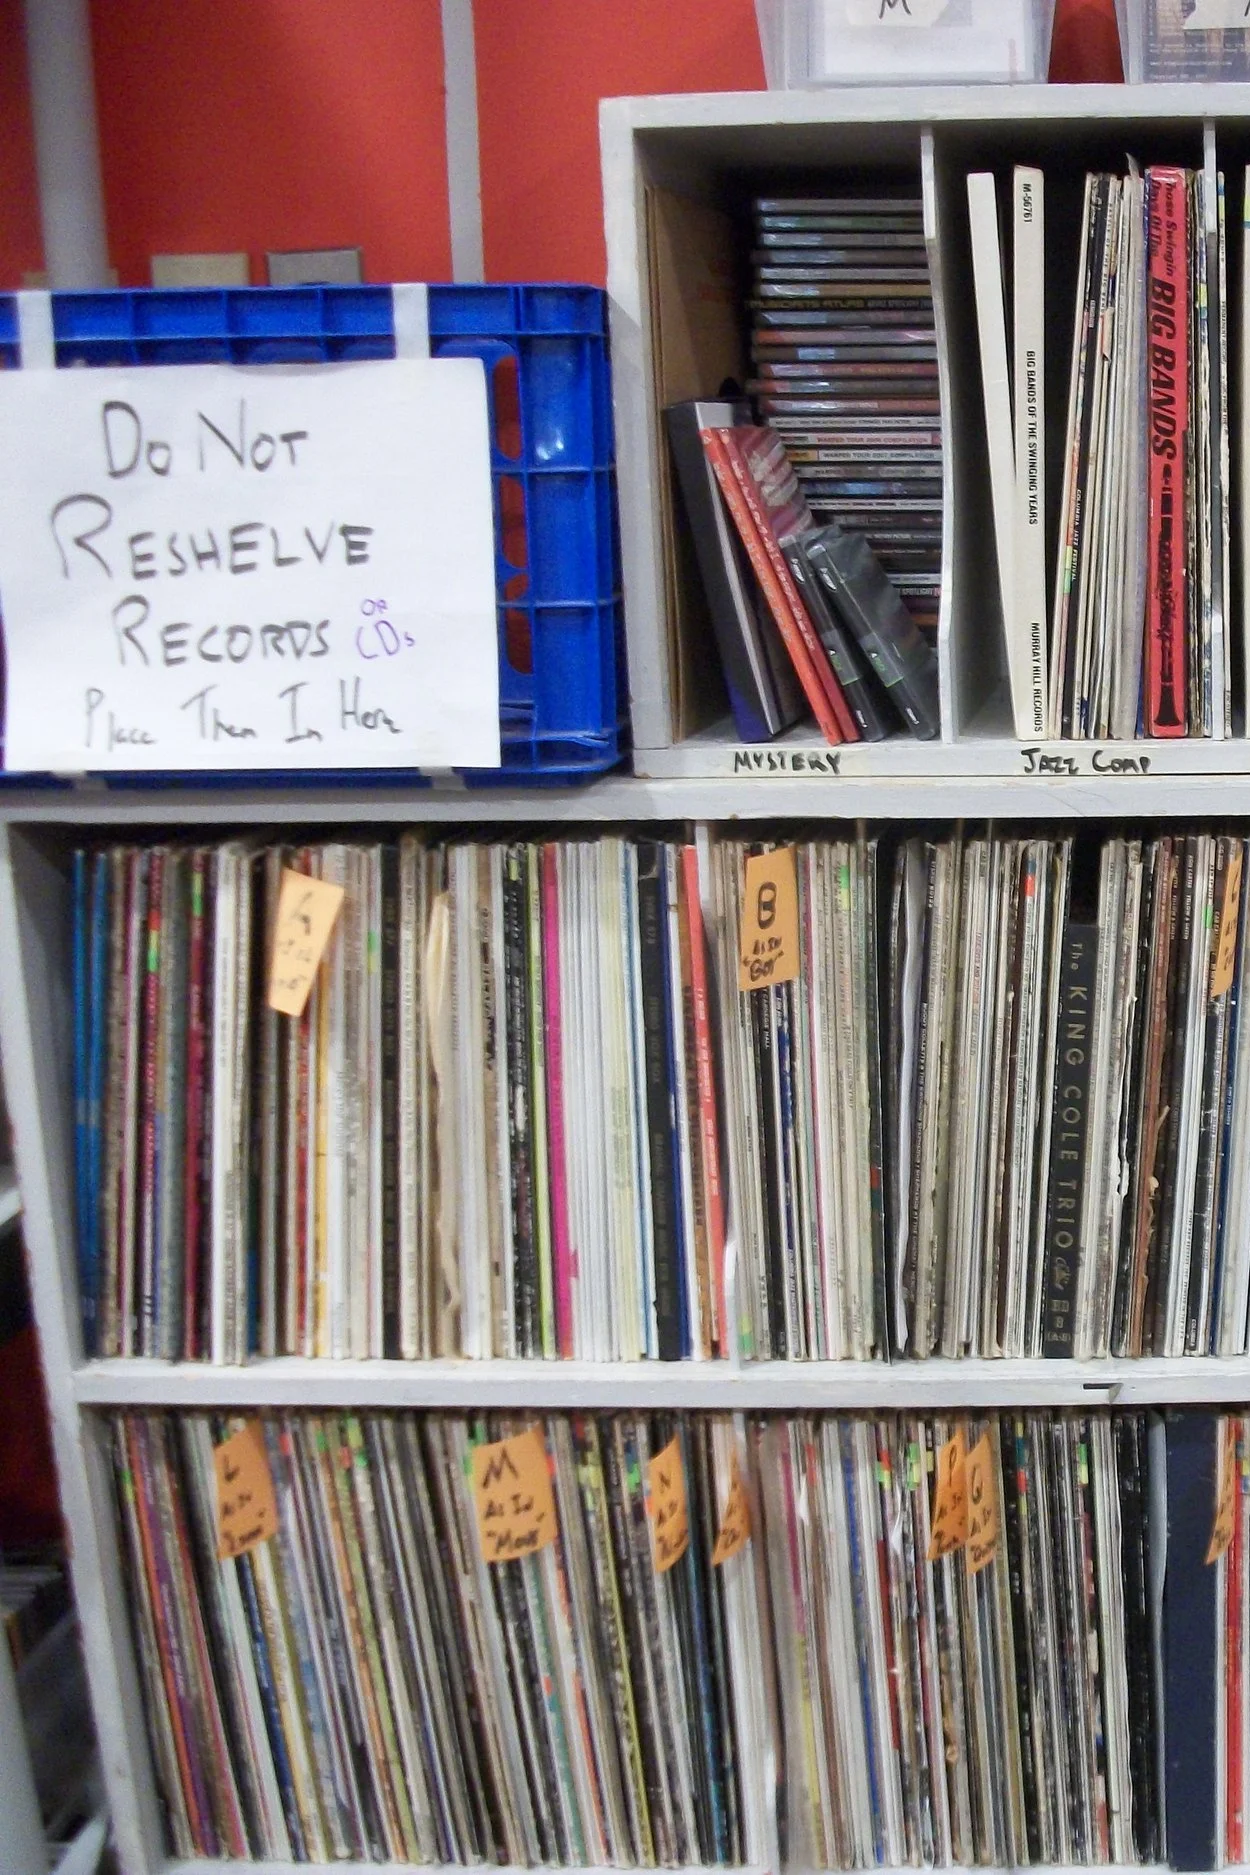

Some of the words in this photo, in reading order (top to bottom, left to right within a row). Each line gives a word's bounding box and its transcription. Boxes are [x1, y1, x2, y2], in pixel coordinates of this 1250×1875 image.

[1023, 184, 1032, 223] M-56761
[1164, 220, 1177, 277] Swingin
[1151, 278, 1176, 339] BIG
[1026, 351, 1036, 368] BIG
[1026, 370, 1036, 403] BANDS
[1152, 344, 1176, 460] BANDS
[1027, 406, 1037, 418] OF
[1028, 421, 1037, 440] THE
[1028, 442, 1038, 491] SWINGING
[1029, 495, 1039, 525] YEARS
[50, 494, 375, 580] RESHELVE
[112, 595, 330, 667] RECORDS
[1031, 623, 1041, 662] MURRAY
[1033, 666, 1042, 686] HILL
[1033, 688, 1043, 732] RECORDS
[734, 751, 842, 775] MYSTERY
[1071, 942, 1083, 971] The
[1066, 986, 1088, 1066] KING
[1059, 1084, 1082, 1161] COLE
[1056, 1180, 1078, 1248] TRIO
[1189, 1318, 1197, 1347] COLUMBIA
